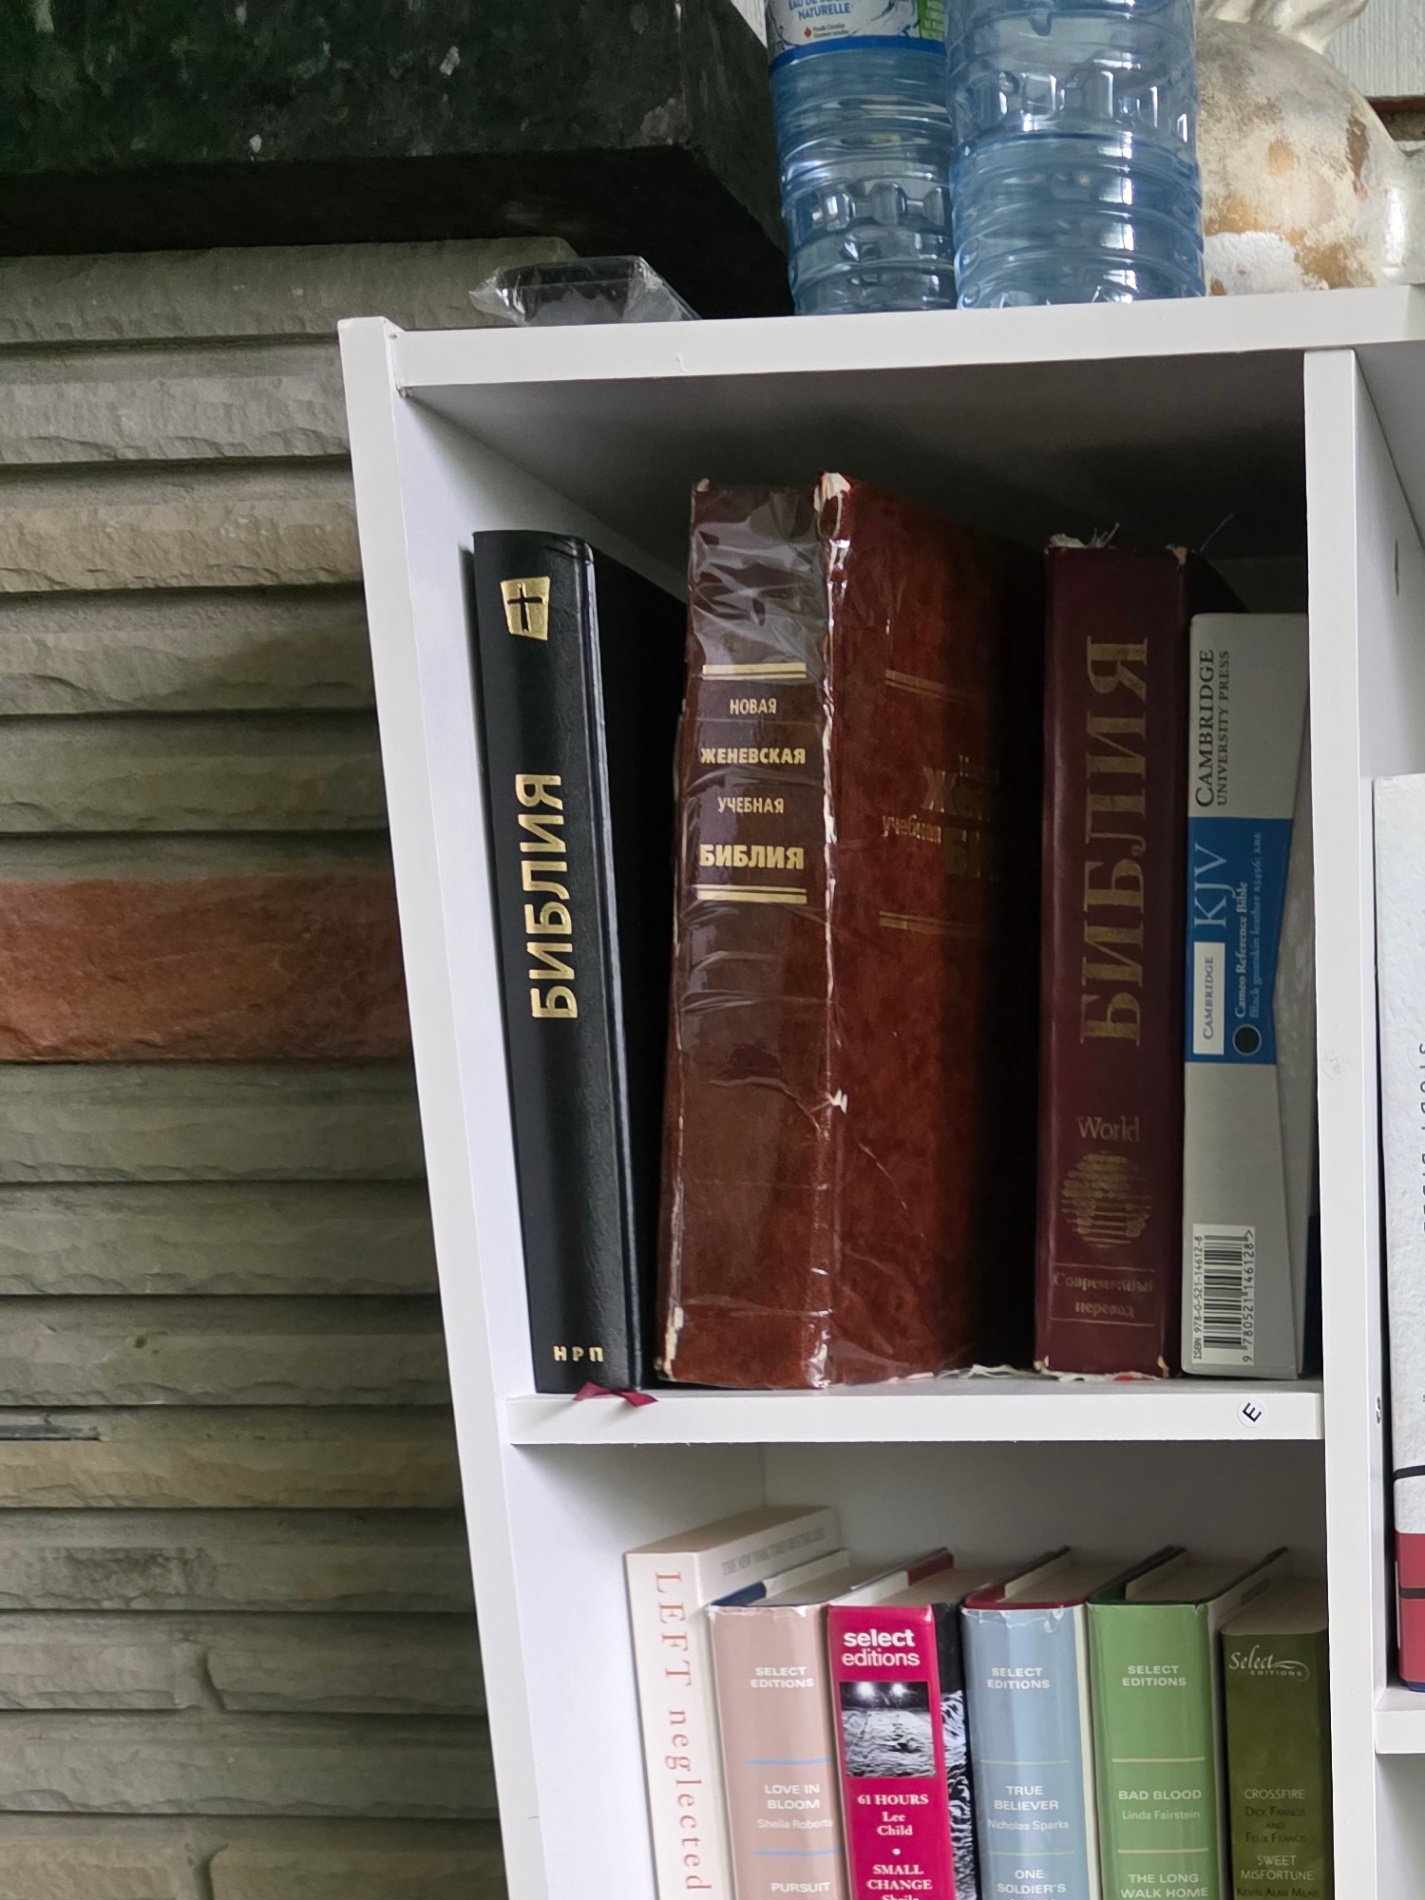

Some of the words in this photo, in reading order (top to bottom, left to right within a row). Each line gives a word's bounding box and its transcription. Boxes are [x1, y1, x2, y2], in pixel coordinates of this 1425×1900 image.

[798, 3, 851, 21] NATURELLE
[1217, 650, 1230, 701] PRESS
[729, 698, 777, 715] НОВАЯ
[1195, 649, 1215, 808] CAMBRIDGE
[700, 747, 806, 765] ЖЕНЕВСКАЯ
[1217, 705, 1229, 806] UNIVERSITY
[717, 796, 785, 814] УЧЕБНАЯ
[1079, 637, 1149, 1047] БИБЛИЯ
[699, 843, 805, 870] БИБЛИЯ
[1193, 841, 1236, 928] KJV
[514, 772, 579, 1021] БИБЛИЯ
[1235, 881, 1248, 913] Bible
[1235, 916, 1248, 974] Reference
[1202, 956, 1215, 1041] CAMBRIDGE
[1235, 976, 1248, 1019] Cameo
[1074, 1115, 1141, 1142] World
[1193, 1235, 1203, 1333] 978-0-521-14612-8
[552, 1344, 605, 1362] НРП
[1193, 1337, 1202, 1360] ISBN
[655, 1571, 693, 1687] LEFT
[843, 1628, 916, 1647] select
[841, 1650, 921, 1667] editions
[755, 1666, 807, 1677] SELECT
[991, 1667, 1043, 1677] SELECT
[1127, 1665, 1180, 1675] SELECT
[750, 1678, 815, 1688] EDITIONS
[986, 1679, 1050, 1689] EDITIONS
[1122, 1677, 1187, 1687] EDITIONS
[1006, 1785, 1044, 1796] TRUE
[1118, 1790, 1149, 1800] BAD
[1153, 1789, 1202, 1800] BLOOD
[1244, 1788, 1306, 1800] CROSSFIRE
[664, 1708, 713, 1891] neglected
[767, 1799, 820, 1810] BLOOM
[994, 1800, 1059, 1811] BELIEVER
[876, 1825, 913, 1836] Child
[1257, 1855, 1297, 1866] SWEET
[873, 1864, 924, 1875] SMALL
[1014, 1869, 1045, 1880] ONE
[1240, 1869, 1315, 1881] MISFORTUNE
[866, 1879, 933, 1891] CHANGE
[1128, 1873, 1155, 1884] THE
[1159, 1873, 1199, 1884] LONG
[771, 1882, 831, 1893] PURSUIT
[996, 1883, 1067, 1894] SOLDIER'S
[1121, 1888, 1169, 1899] WALK
[1171, 1887, 1209, 1898] HOME
